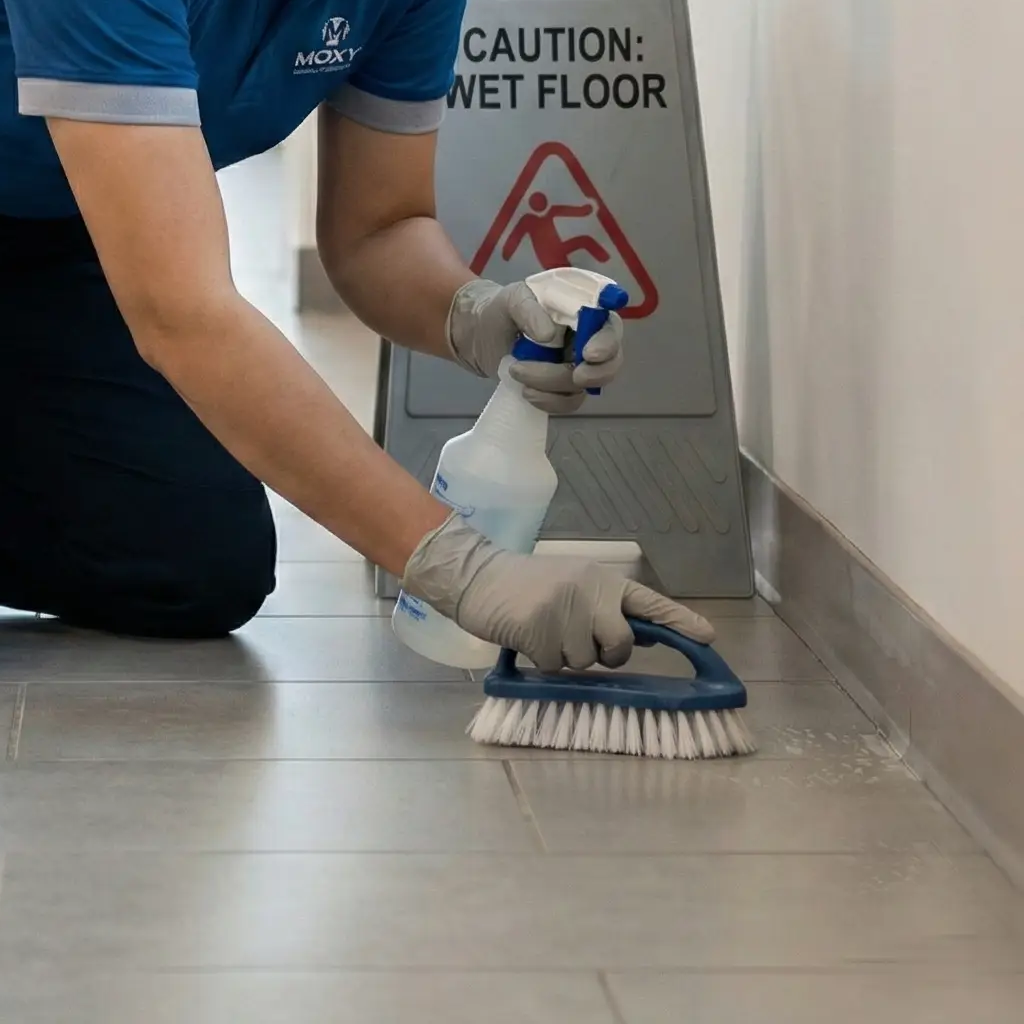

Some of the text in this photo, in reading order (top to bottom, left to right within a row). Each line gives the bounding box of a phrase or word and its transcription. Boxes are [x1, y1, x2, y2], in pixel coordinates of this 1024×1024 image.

[294, 47, 362, 66] MOXY
[463, 27, 643, 62] CAUTION:
[447, 74, 667, 109] WET FLOOR
